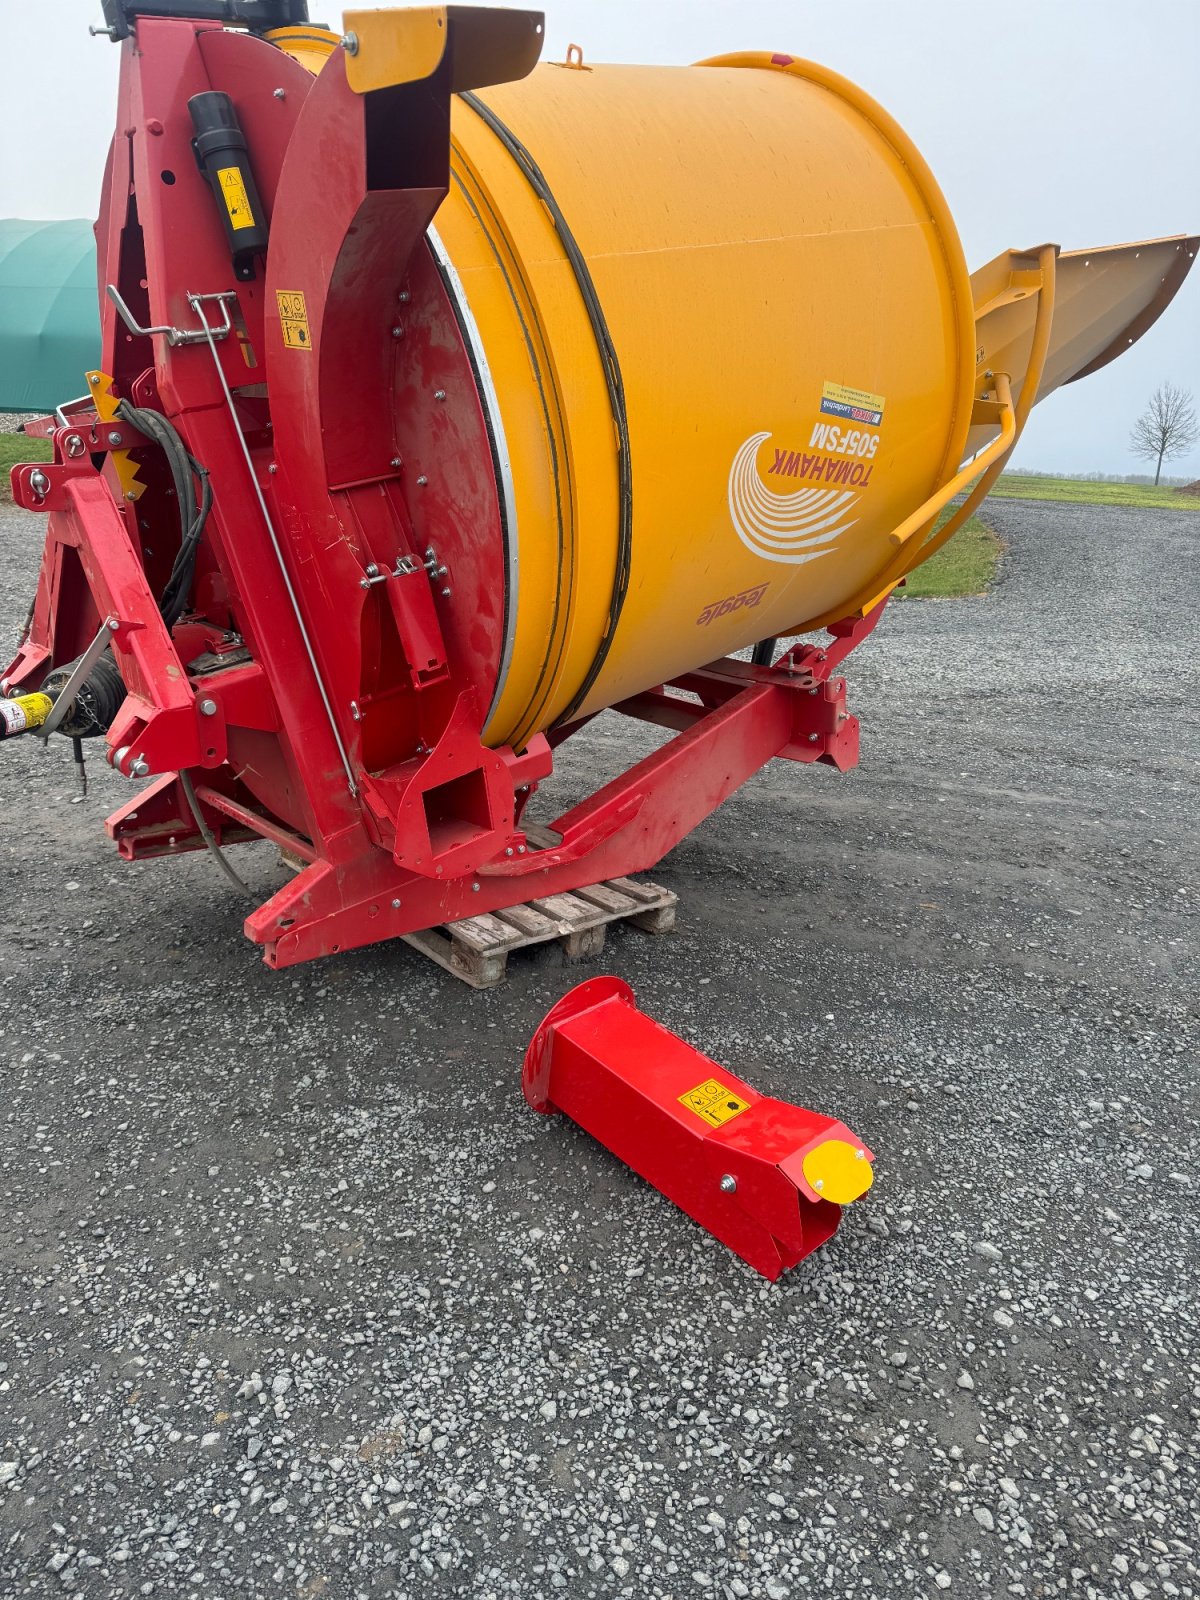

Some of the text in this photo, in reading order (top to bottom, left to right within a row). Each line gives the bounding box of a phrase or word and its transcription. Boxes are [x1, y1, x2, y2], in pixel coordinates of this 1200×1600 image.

[809, 423, 880, 458] 505FSM
[768, 449, 873, 487] TOMAHAWK
[696, 583, 769, 626] Teagle
